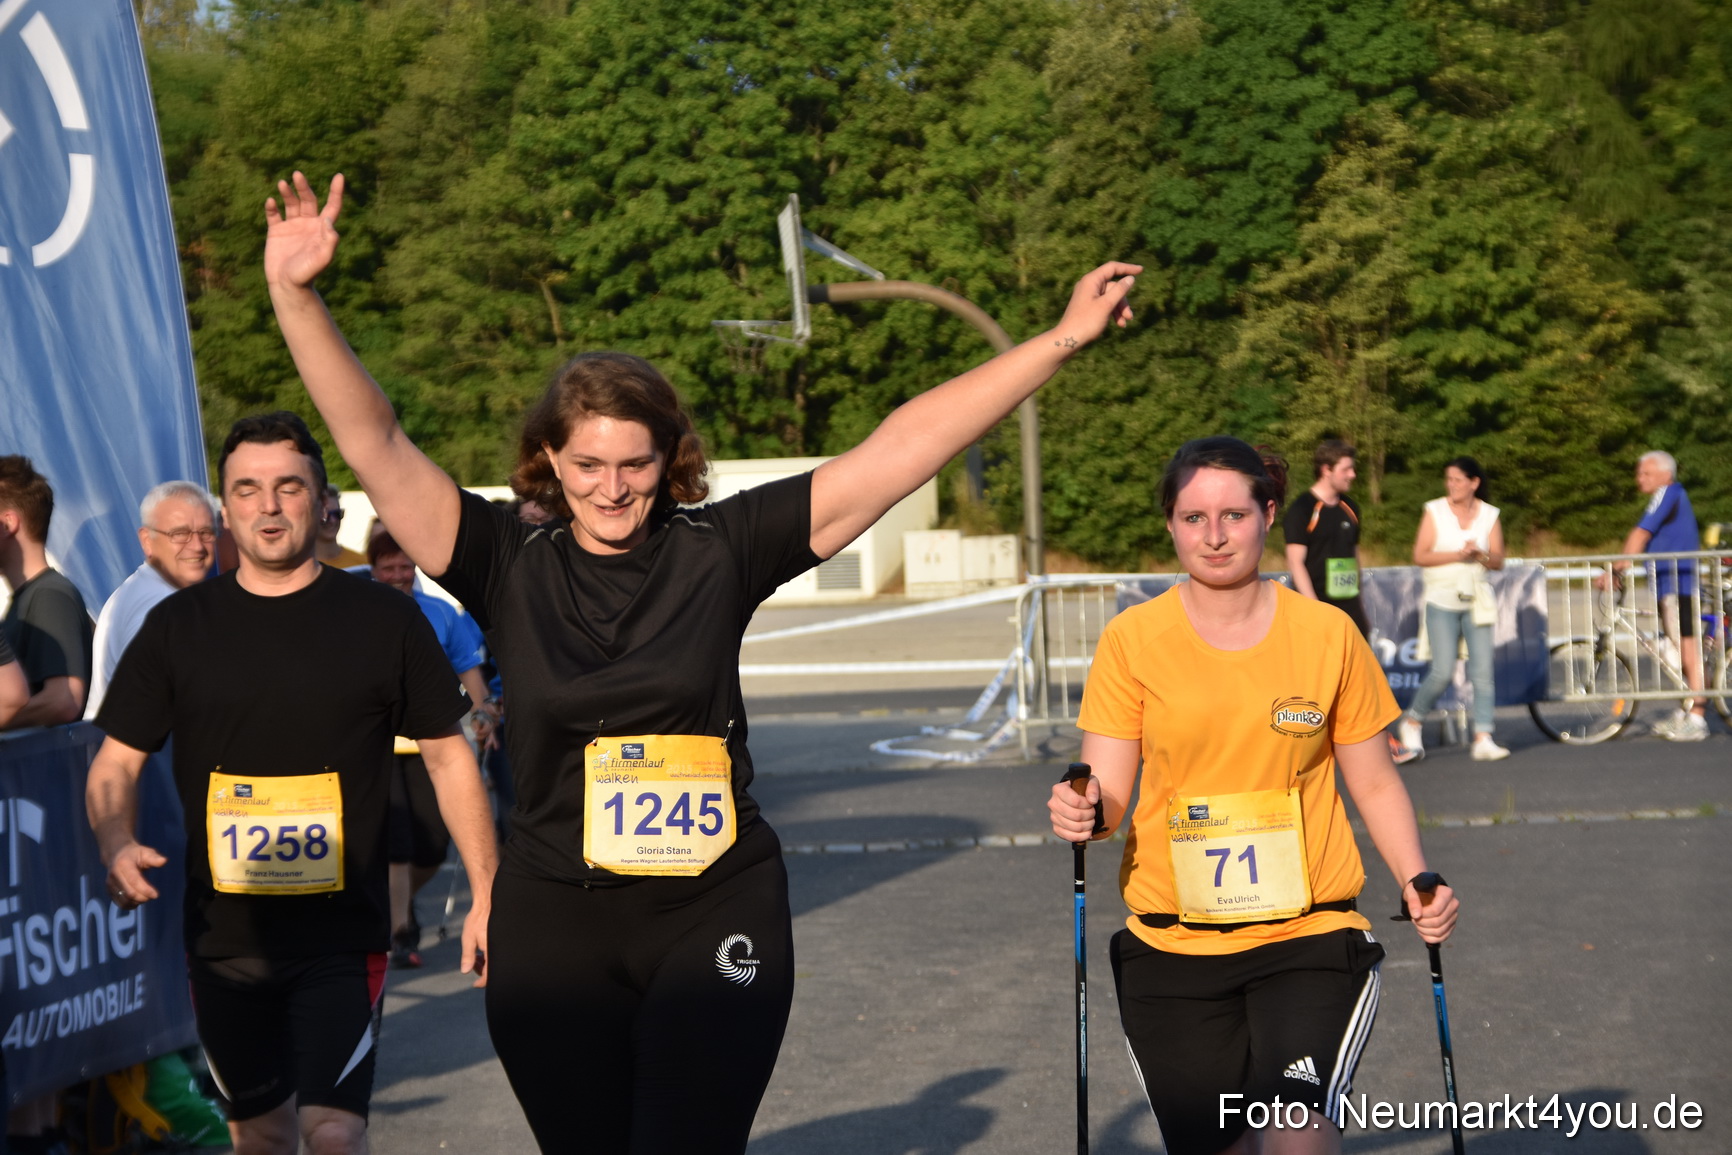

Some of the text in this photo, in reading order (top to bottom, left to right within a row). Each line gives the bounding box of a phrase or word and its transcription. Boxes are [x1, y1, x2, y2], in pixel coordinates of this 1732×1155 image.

[1277, 708, 1312, 725] plank
[611, 758, 666, 768] firmenlauf
[595, 773, 639, 784] walken
[225, 796, 271, 806] firmenlauf
[214, 808, 249, 818] walken
[604, 792, 724, 836] 1245
[1181, 816, 1229, 828] firmenlauf
[222, 824, 329, 862] 1258
[1171, 833, 1207, 843] walken
[636, 847, 692, 855] Gloria Stana
[1205, 845, 1258, 887] 71
[1217, 894, 1261, 905] Eva Ulrich
[1, 972, 145, 1050] AUTOMOBILE
[1283, 1069, 1321, 1086] adidas
